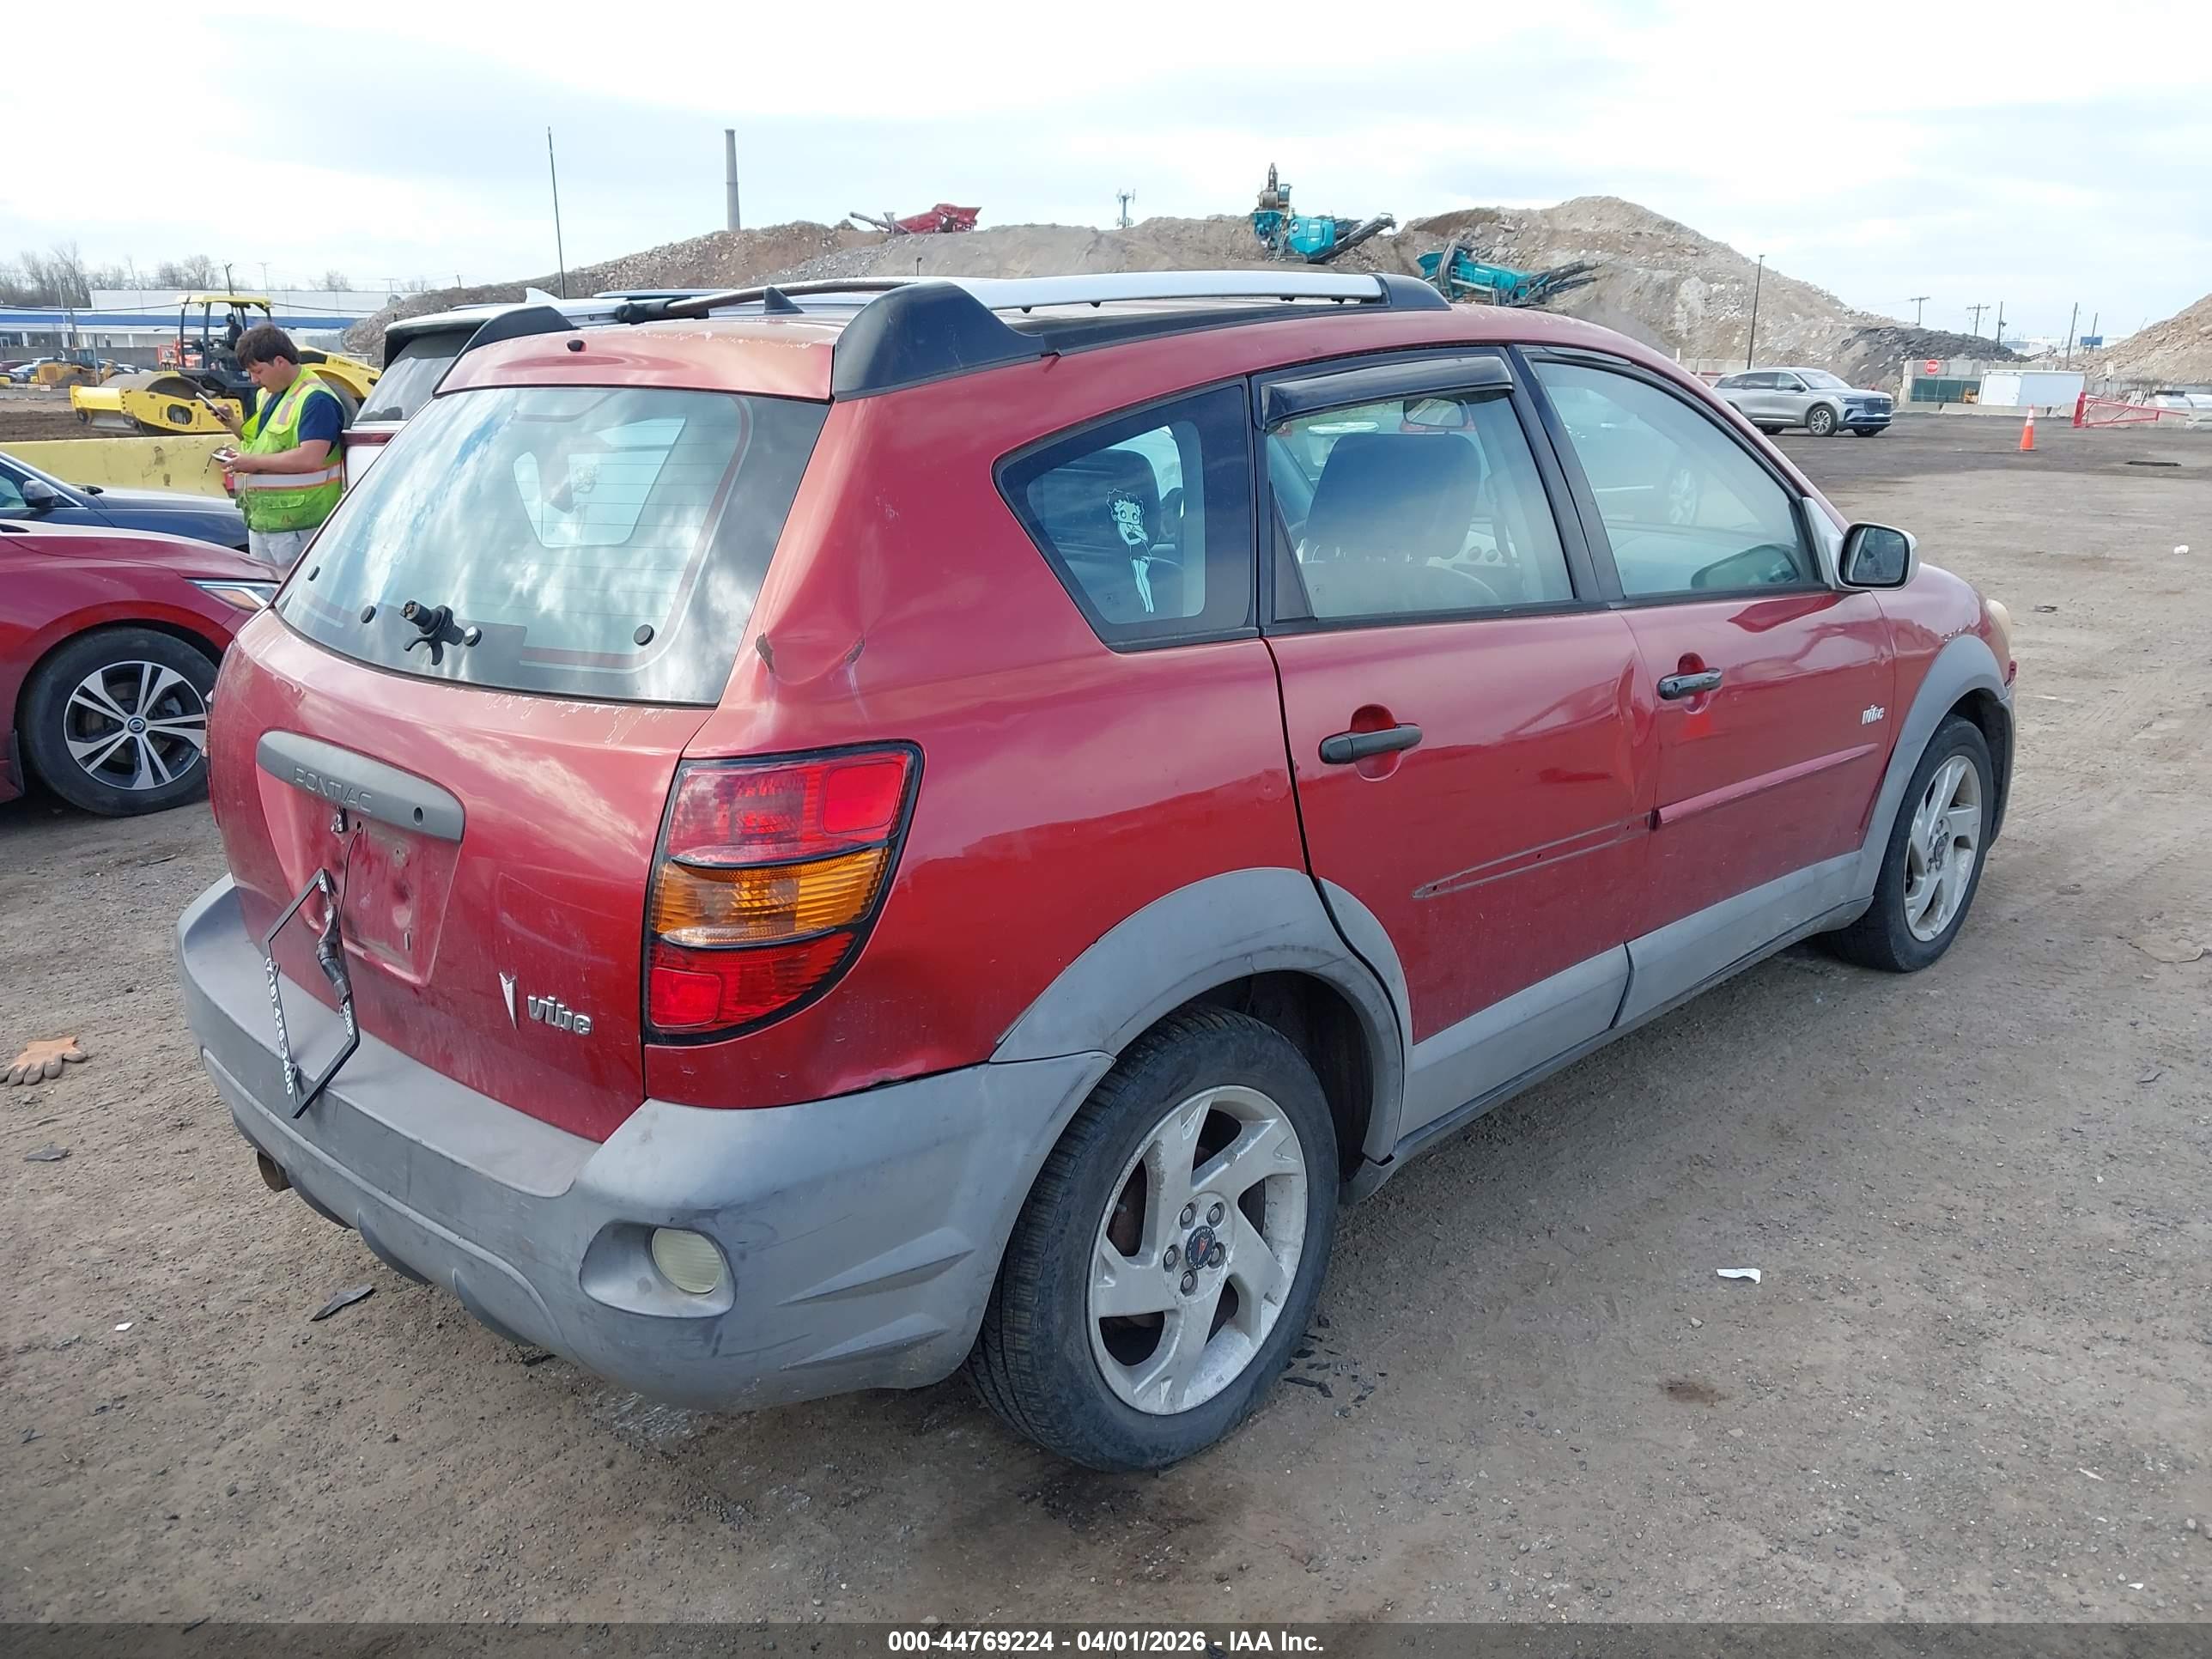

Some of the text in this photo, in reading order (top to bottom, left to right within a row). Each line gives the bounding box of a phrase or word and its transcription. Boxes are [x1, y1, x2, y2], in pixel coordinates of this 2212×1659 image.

[293, 767, 373, 813] PONTIAC
[343, 1002, 355, 1041] CORP.
[526, 994, 592, 1036] vibe
[274, 1007, 294, 1095] 426-3400
